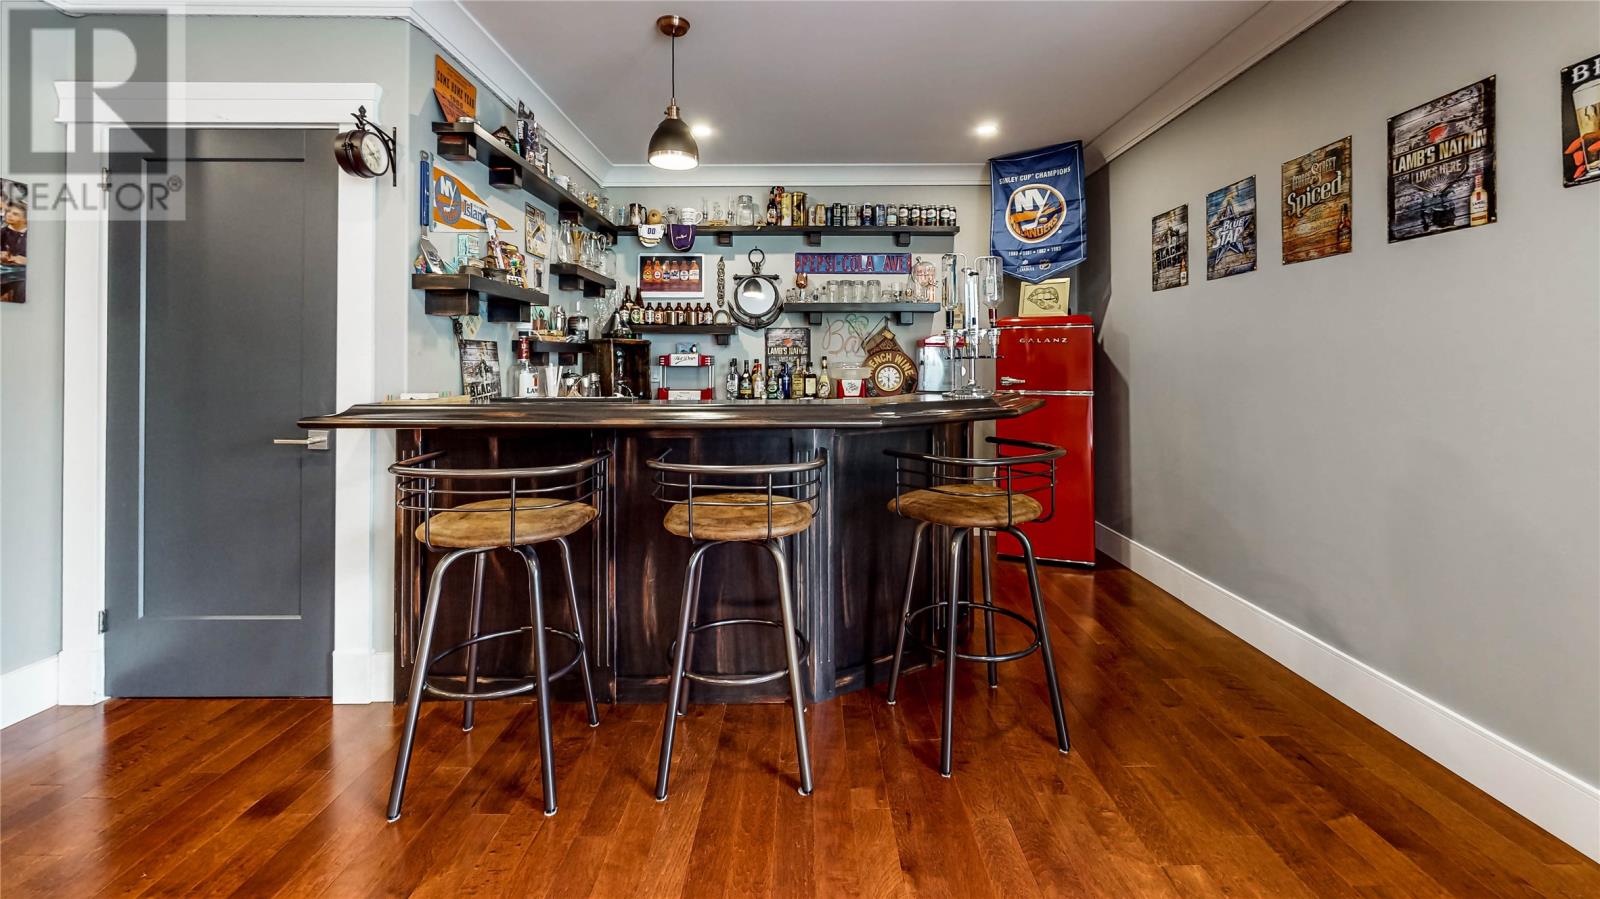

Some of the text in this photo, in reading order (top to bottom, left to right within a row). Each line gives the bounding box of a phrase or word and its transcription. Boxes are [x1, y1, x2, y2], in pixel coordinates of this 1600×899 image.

[1393, 128, 1487, 175] LAMB'S NATION
[1035, 166, 1071, 179] CHAMPIONS
[1415, 159, 1462, 183] LIVES HERE
[1014, 188, 1050, 213] NY
[1287, 170, 1342, 218] Spiced
[1224, 217, 1244, 230] BLUE
[1212, 226, 1243, 249] STAR
[1156, 245, 1181, 261] BLACK
[894, 353, 914, 376] WINE
